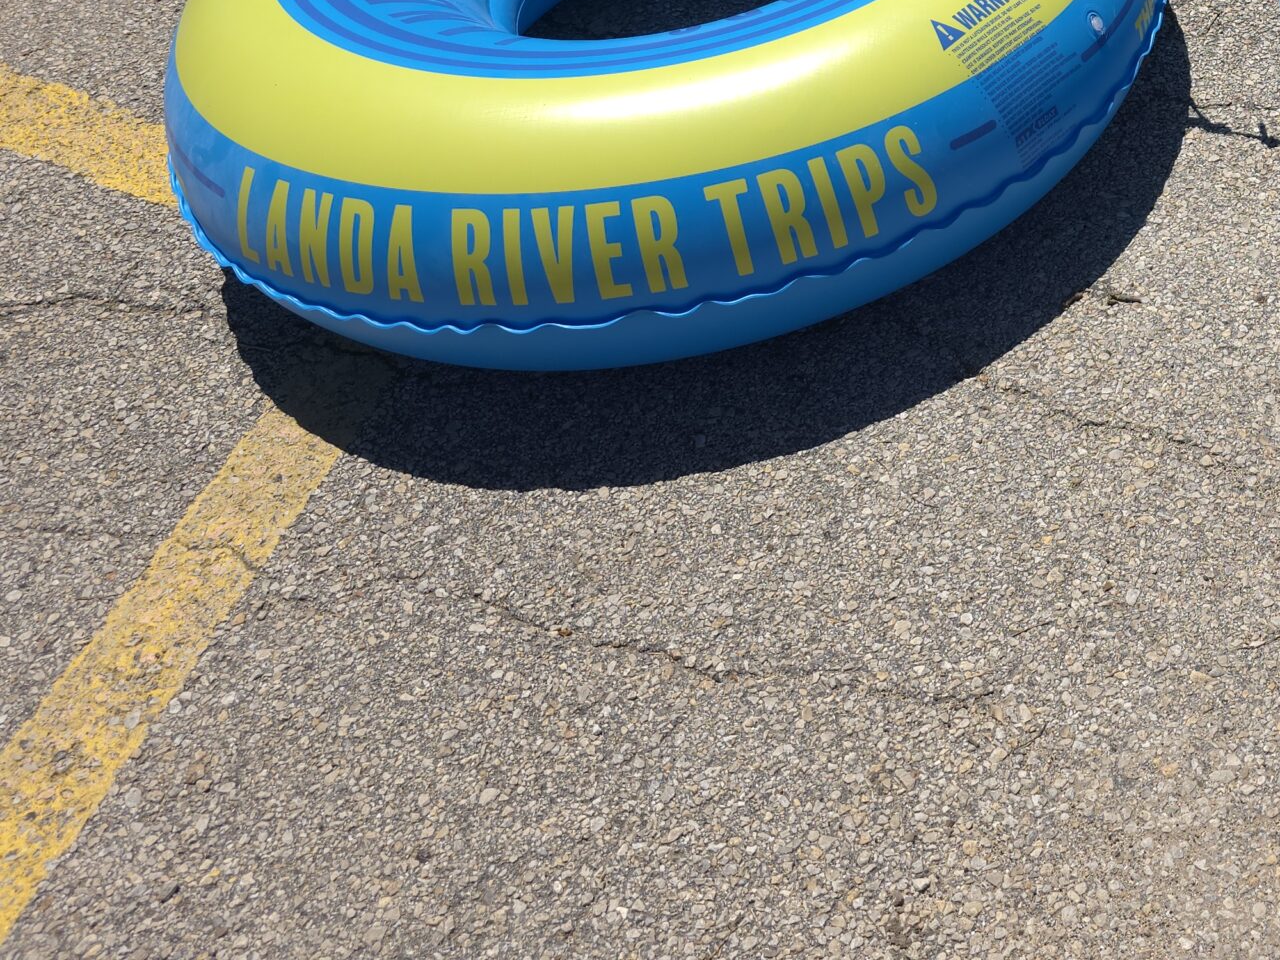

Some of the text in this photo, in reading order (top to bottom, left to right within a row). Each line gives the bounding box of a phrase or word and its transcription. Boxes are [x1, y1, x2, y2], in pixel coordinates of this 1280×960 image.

[236, 125, 938, 306] LANDA RIVER TRIPS
